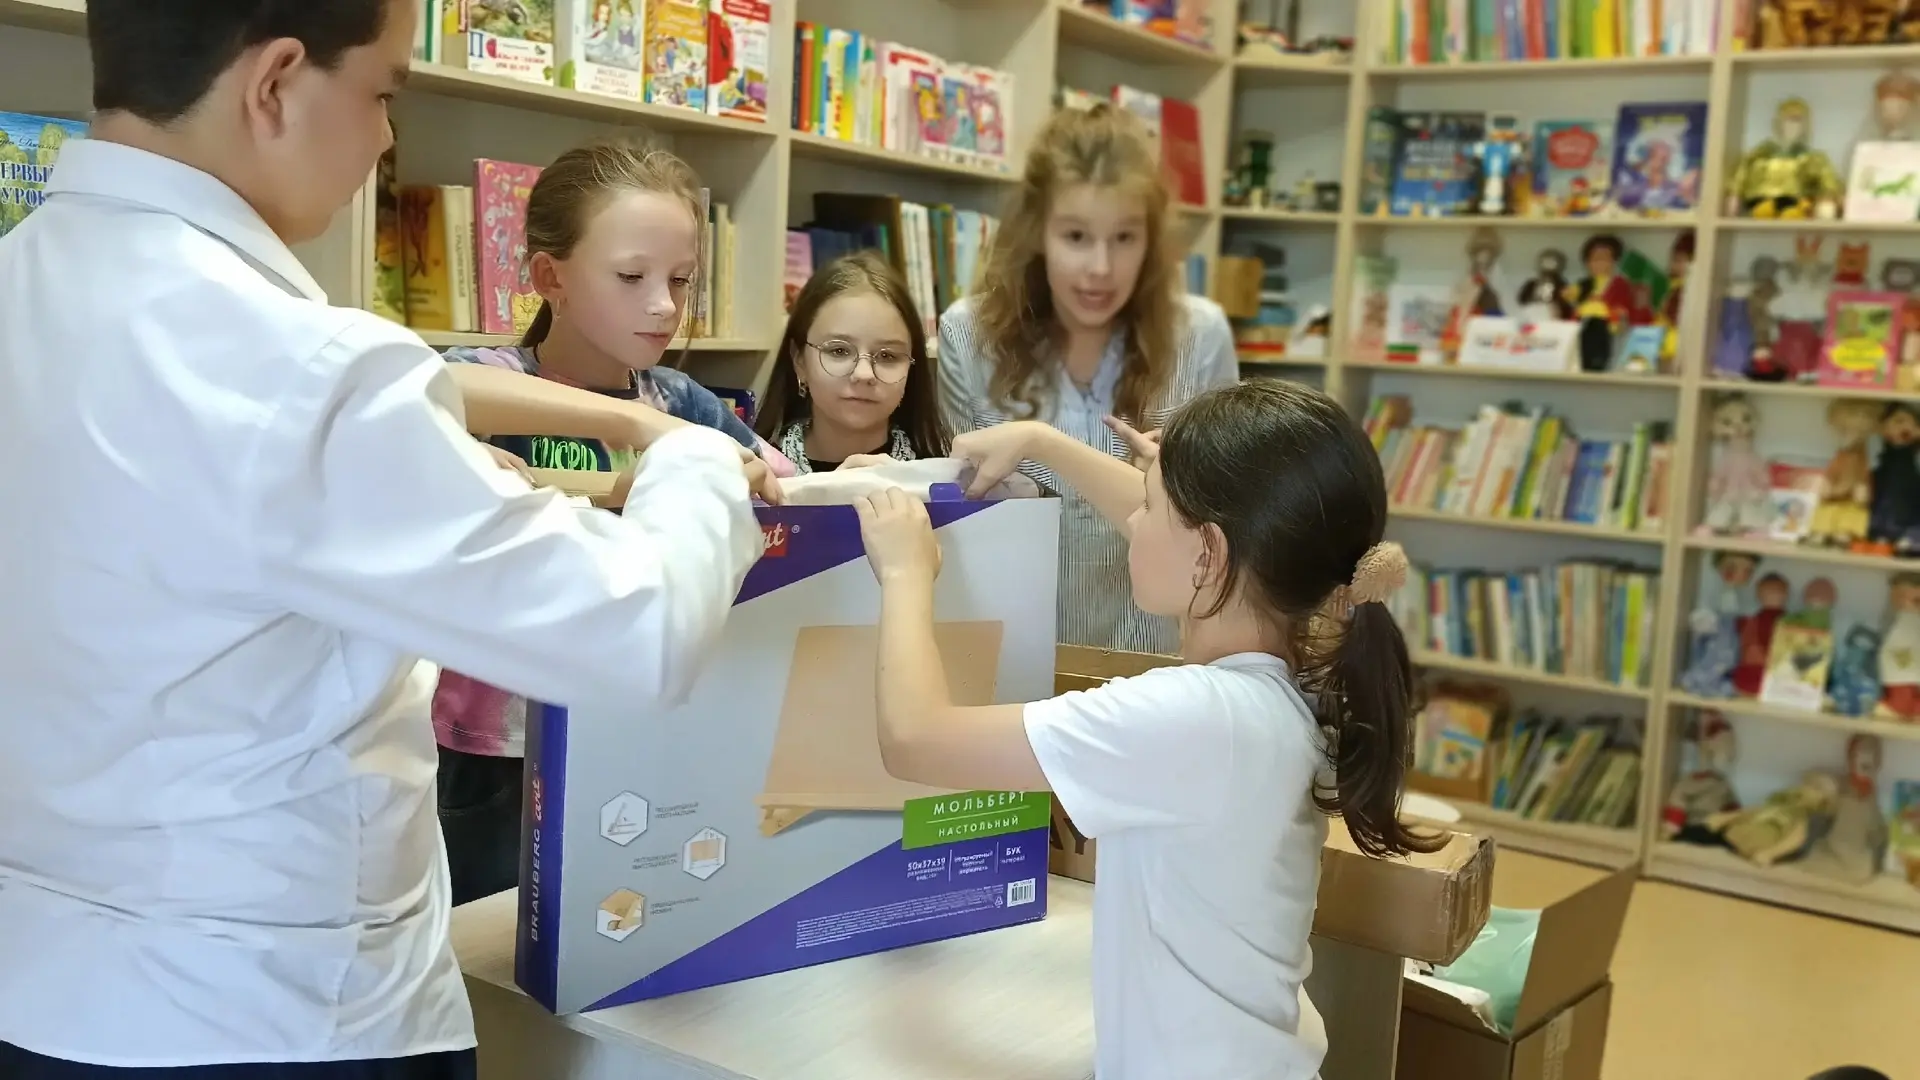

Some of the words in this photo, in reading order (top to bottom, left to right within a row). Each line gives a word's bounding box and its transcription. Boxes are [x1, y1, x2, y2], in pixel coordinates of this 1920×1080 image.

[763, 522, 785, 549] rt
[933, 791, 1025, 816] МОЛЬБЕРТ
[938, 815, 1019, 838] НАСТОЛЬНЫЙ
[1005, 846, 1022, 856] БУК
[531, 828, 541, 942] BRAUBERG
